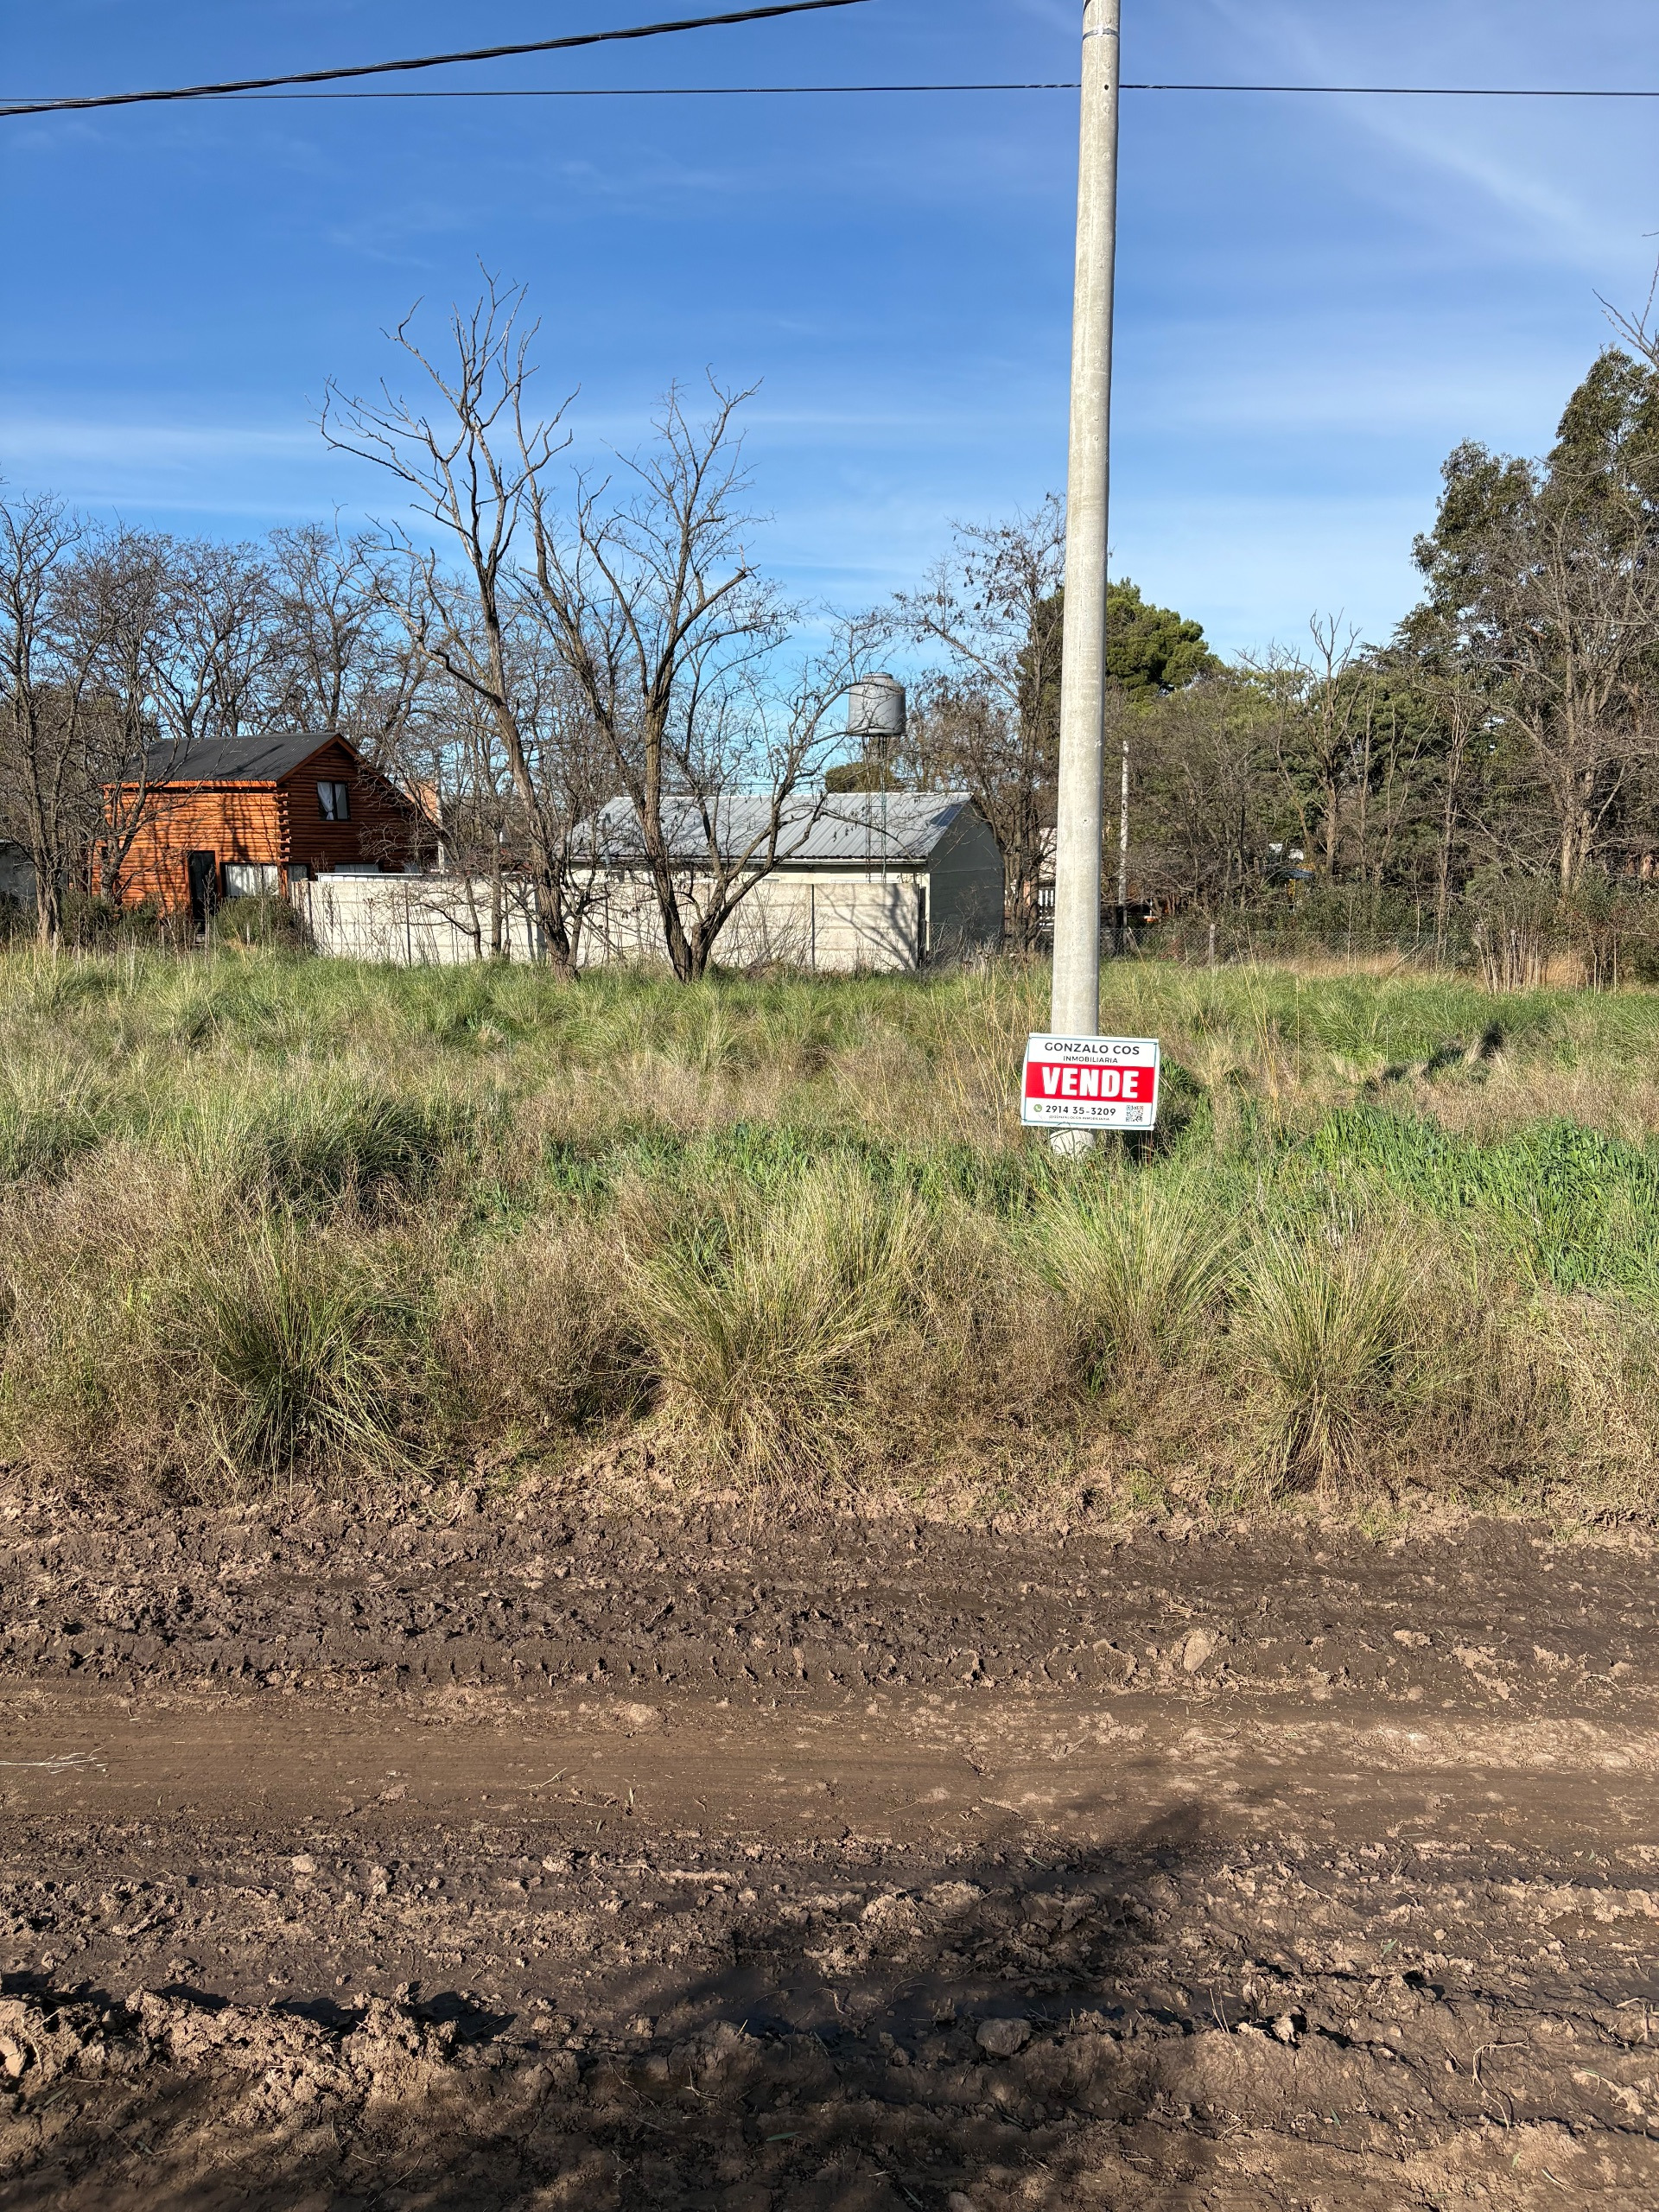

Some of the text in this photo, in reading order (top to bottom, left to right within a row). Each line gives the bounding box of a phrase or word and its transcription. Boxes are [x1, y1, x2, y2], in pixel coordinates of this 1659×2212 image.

[1045, 1042, 1140, 1055] GONZALO COS
[1063, 1055, 1118, 1064] INMOBILIARIA
[1042, 1067, 1139, 1098] VENDE
[1046, 1105, 1116, 1116] 2914 35-3209
